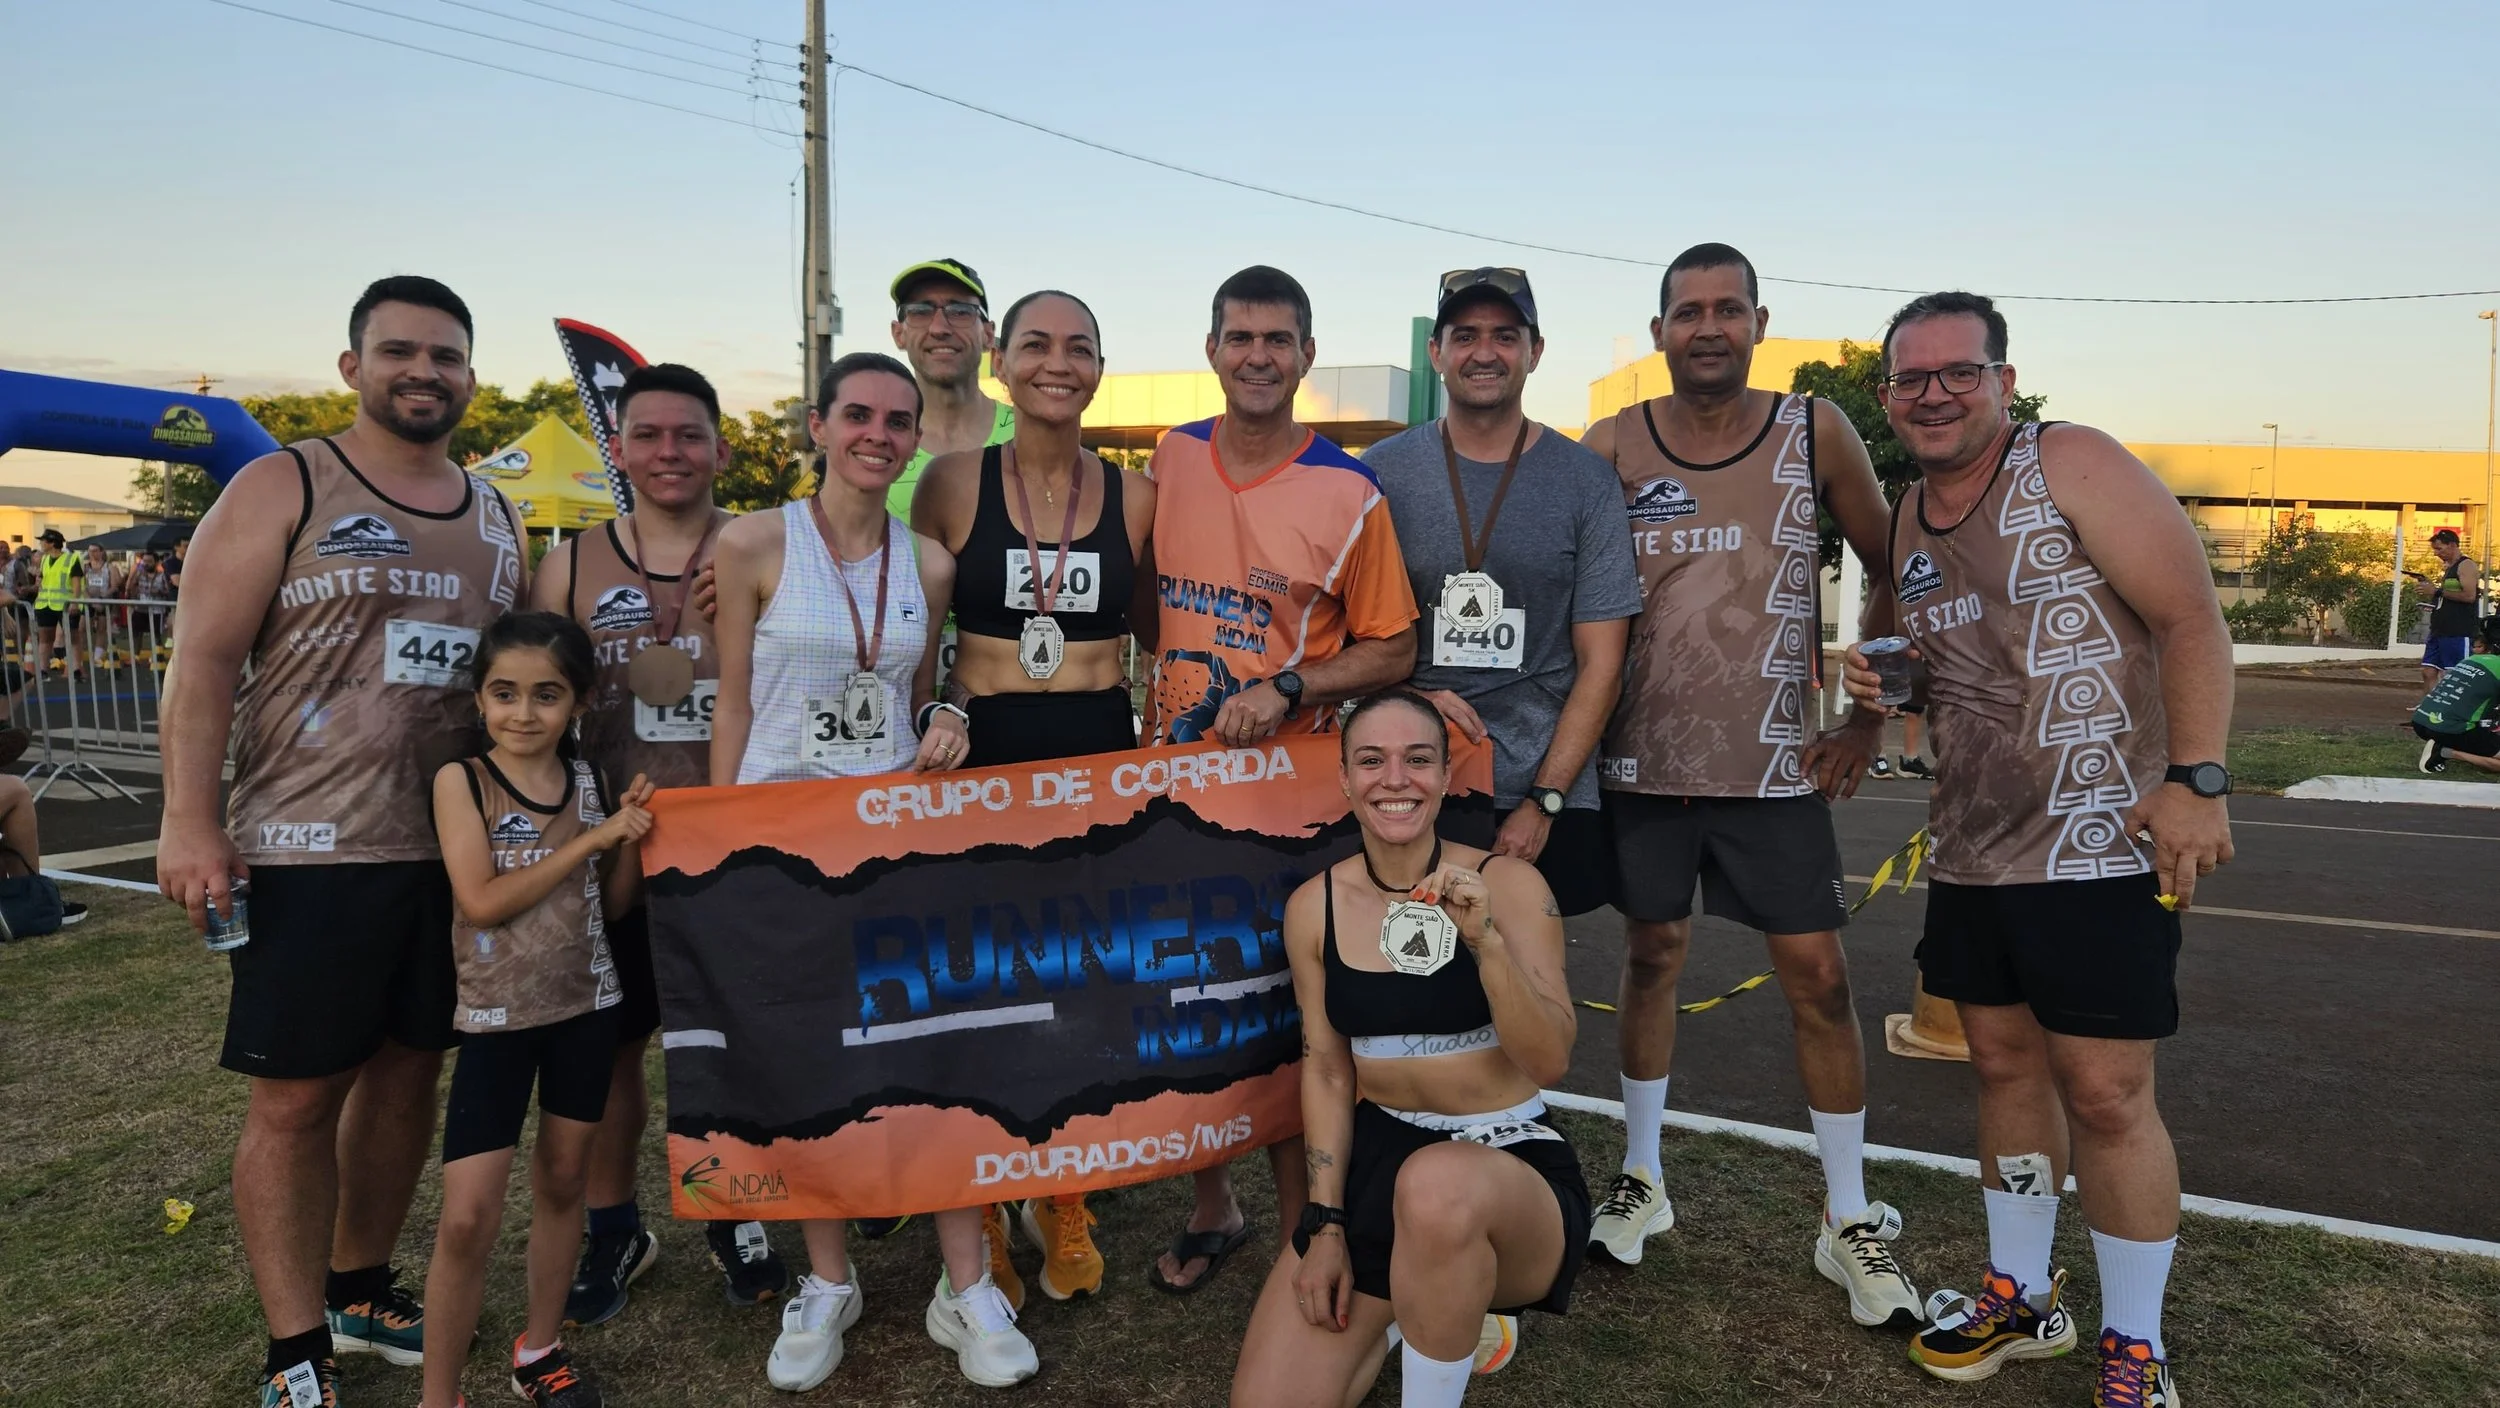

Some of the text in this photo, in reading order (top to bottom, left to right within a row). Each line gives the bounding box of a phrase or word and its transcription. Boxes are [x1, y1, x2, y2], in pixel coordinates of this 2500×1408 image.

[153, 427, 213, 444] DINOSSAUROS
[1627, 502, 1696, 517] DINOSSAUROS
[318, 541, 410, 555] DINOSSAUROS
[1018, 565, 1091, 595] 240
[1247, 573, 1288, 596] EDMIR
[1250, 566, 1288, 583] PROFESSOR
[280, 567, 377, 609] MONTE
[1158, 573, 1273, 629] RUNNERS
[1443, 623, 1515, 651] 440
[398, 636, 473, 670] 442
[856, 746, 1297, 829] GRUPO DE CORRIDA
[262, 825, 310, 845] YZK
[1404, 912, 1424, 921] MONTE
[1443, 937, 1451, 959] TERRA
[1401, 1029, 1491, 1057] Studio
[970, 1113, 1252, 1185] DOURADOS/MS
[729, 1169, 789, 1197] INDAIÁ
[952, 1308, 969, 1330] FILA
